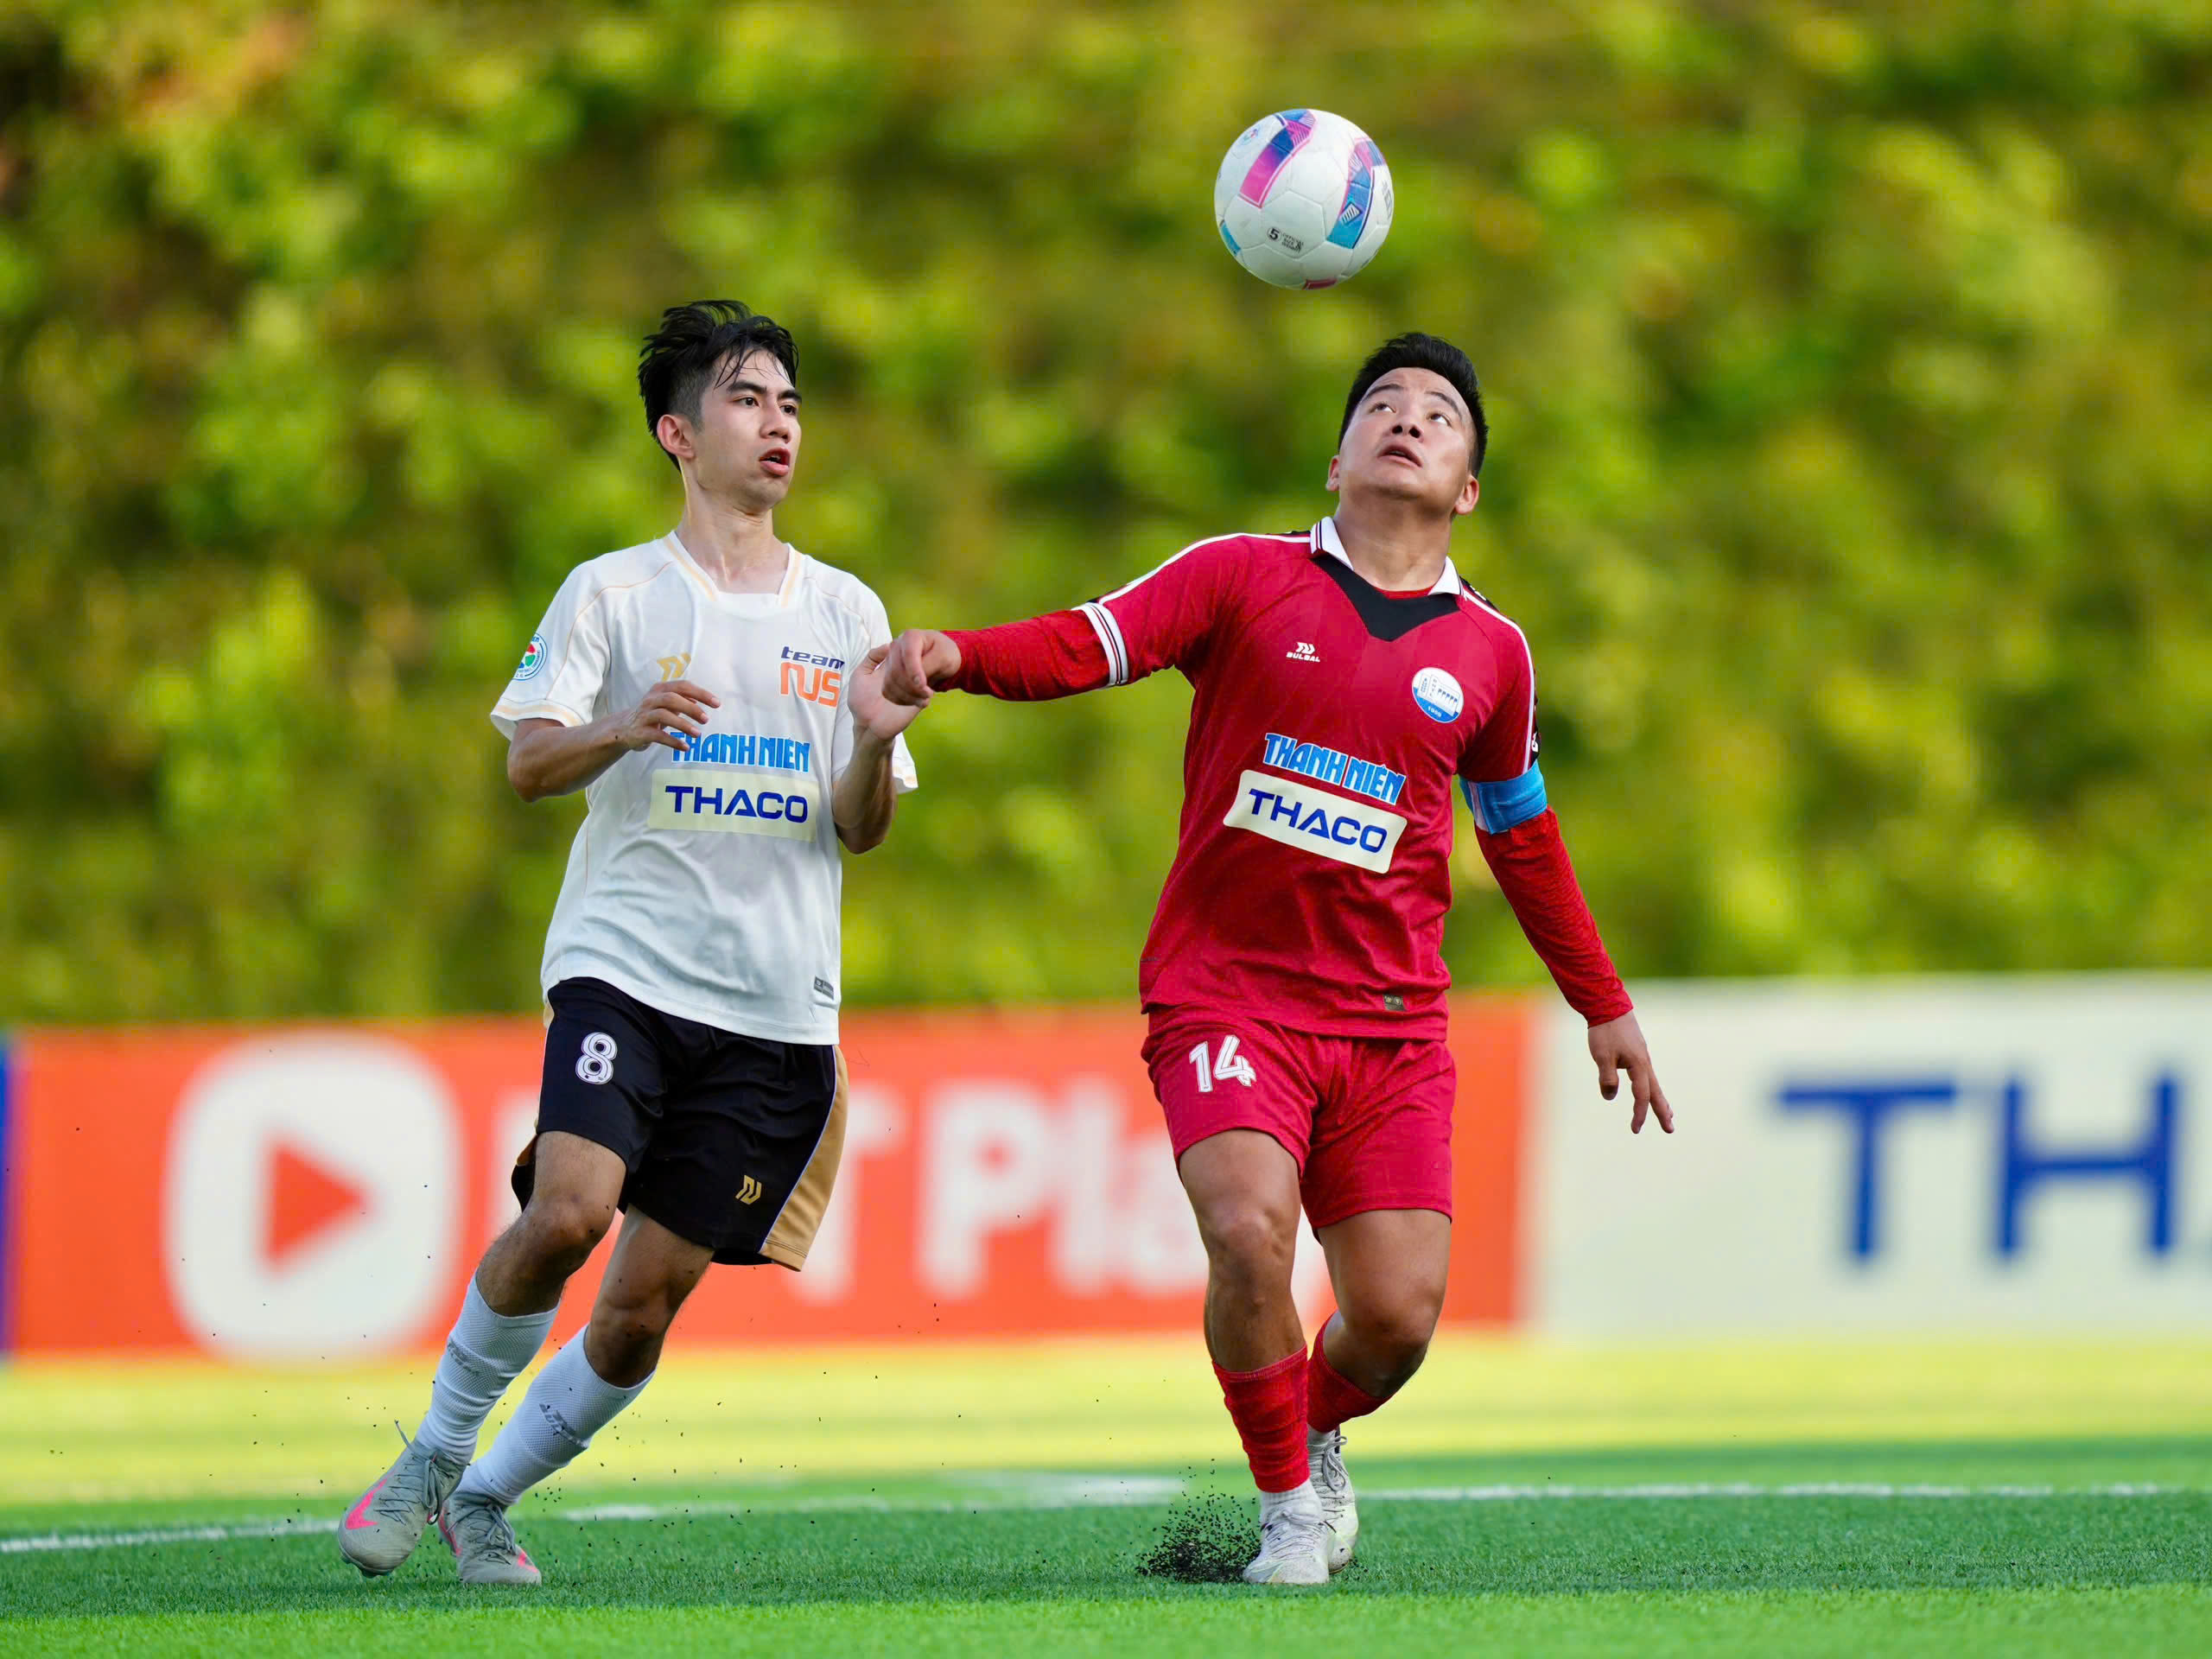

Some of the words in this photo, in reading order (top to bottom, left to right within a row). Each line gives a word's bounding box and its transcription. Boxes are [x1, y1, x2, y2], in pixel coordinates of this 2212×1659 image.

[1269, 227, 1280, 240] 5
[781, 646, 844, 670] team
[671, 731, 756, 766] THANH
[1263, 733, 1349, 785] THANH
[665, 785, 808, 823] THACO
[1249, 788, 1388, 854] THACO
[575, 1032, 618, 1085] 8
[1189, 1034, 1256, 1093] 14
[1771, 1067, 2212, 1263] TH
[920, 1078, 1331, 1313] Pla
